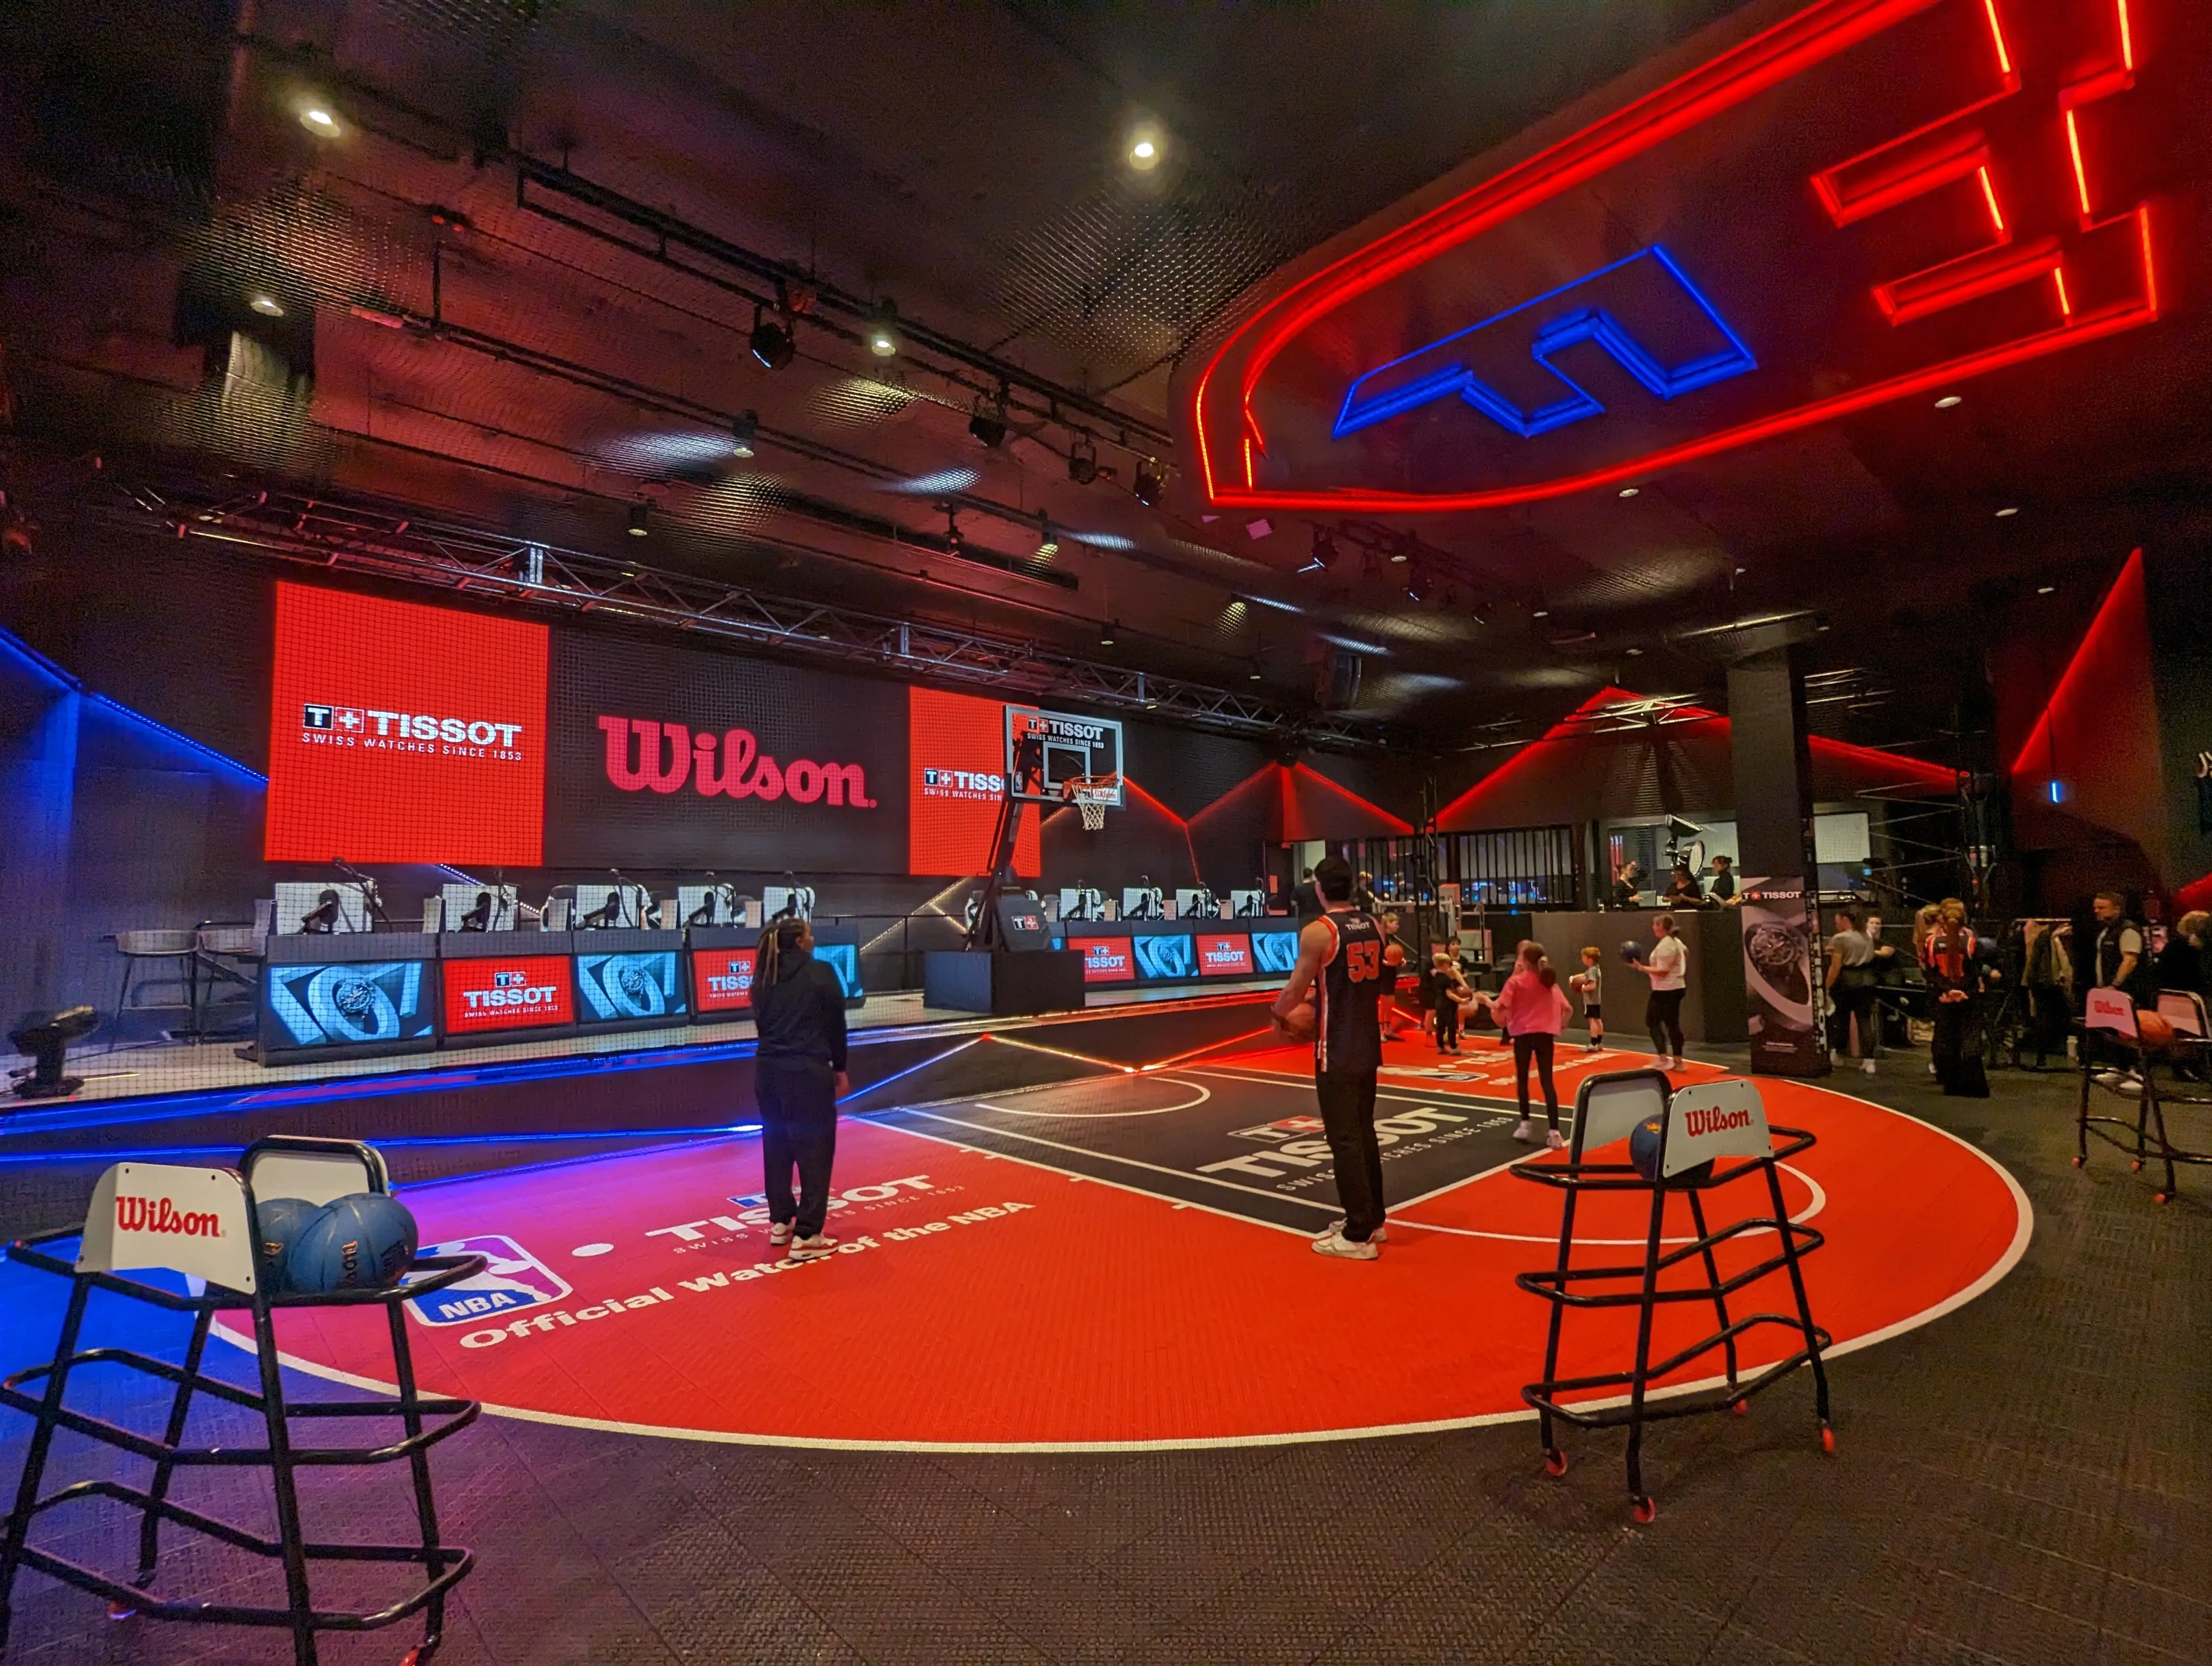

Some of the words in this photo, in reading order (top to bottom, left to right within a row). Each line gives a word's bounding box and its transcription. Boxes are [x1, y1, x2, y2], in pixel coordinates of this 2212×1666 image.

[367, 709, 523, 748] TISSOT
[1027, 733, 1046, 741] SWISS
[1047, 735, 1074, 745] WATCHES
[1075, 739, 1091, 748] SINCE
[1049, 720, 1104, 740] TISSOT
[301, 732, 355, 747] SWISS
[364, 738, 435, 754] WATCHES
[442, 745, 486, 758] SINCE
[492, 749, 523, 761] 1853
[599, 715, 868, 808] Wilson
[924, 787, 949, 797] SWISS
[952, 791, 987, 800] WATCHES
[1761, 891, 1802, 899] TISSOT
[1205, 951, 1245, 963] TISSOT
[1347, 939, 1380, 983] 53
[708, 975, 754, 991] TISS
[463, 986, 557, 1009] TISSOT
[1684, 1105, 1750, 1137] Wilson
[115, 1196, 220, 1237] Wilson
[460, 1286, 675, 1349] Official
[838, 1235, 881, 1254] of
[882, 1221, 951, 1241] the
[947, 1201, 1036, 1225] NBA
[439, 1292, 517, 1319] NBA
